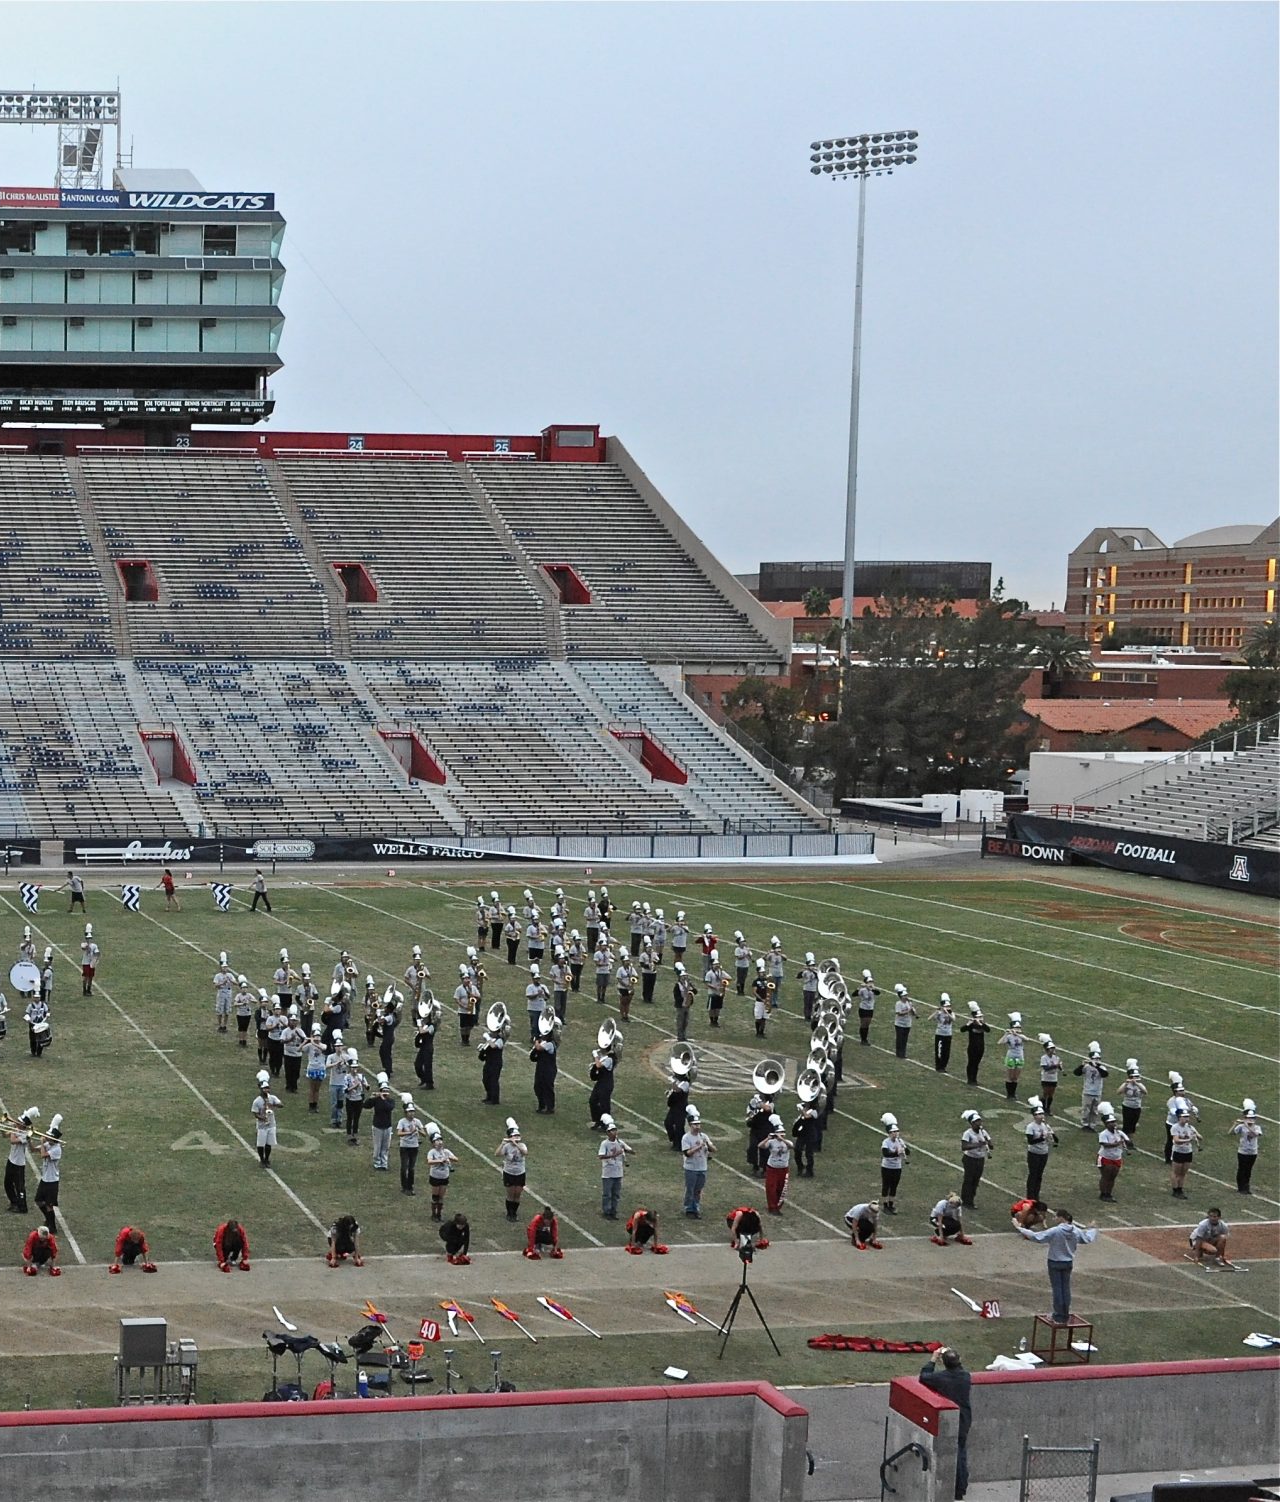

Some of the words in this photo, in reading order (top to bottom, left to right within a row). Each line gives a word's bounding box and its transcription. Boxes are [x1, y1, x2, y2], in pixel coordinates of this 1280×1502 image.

[0, 192, 6, 200] 11
[26, 193, 60, 201] McALISTER
[61, 193, 66, 201] 5
[96, 195, 120, 203] CASON
[129, 193, 267, 209] WILDCATS
[176, 438, 190, 447] 23
[349, 441, 363, 450] 24
[495, 443, 509, 452] 25
[372, 844, 428, 855] WELLS
[987, 841, 1020, 853] BEAR
[1022, 845, 1064, 861] DOWN
[1071, 836, 1116, 851] ARIZONA
[1114, 842, 1176, 864] FOOTBALL
[169, 1130, 321, 1154] 40
[984, 1302, 1000, 1318] 30
[420, 1321, 437, 1339] 40
